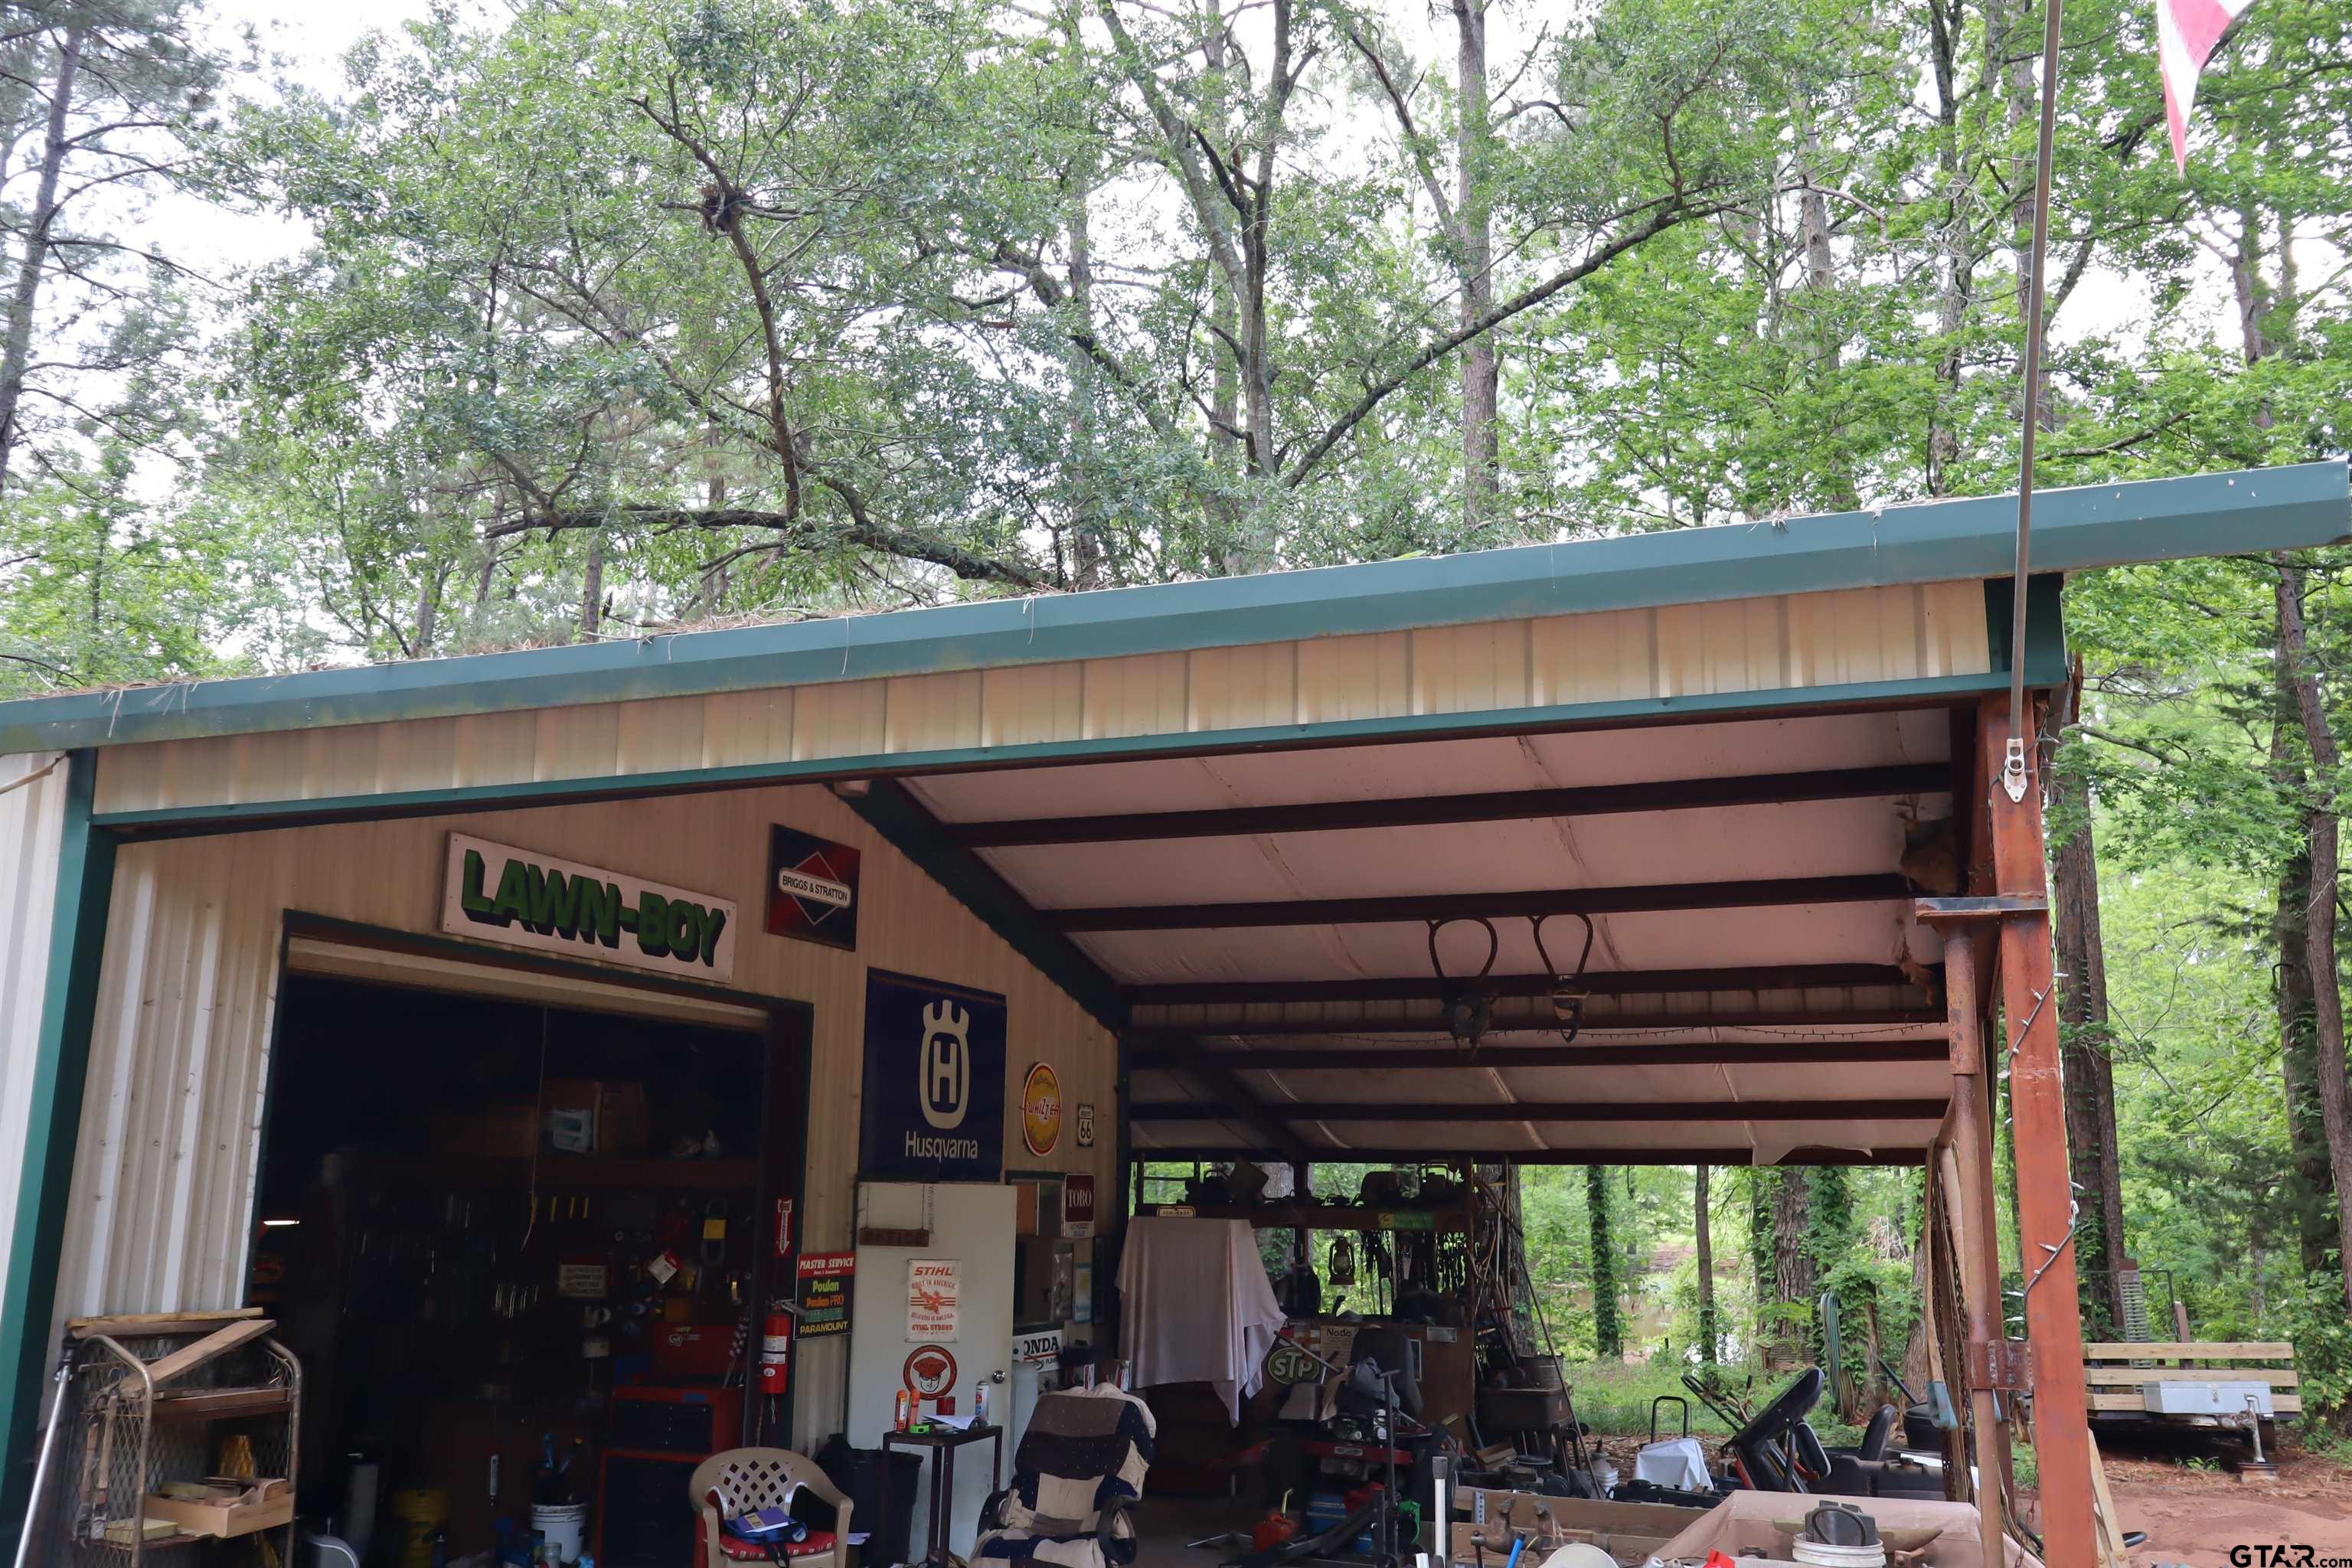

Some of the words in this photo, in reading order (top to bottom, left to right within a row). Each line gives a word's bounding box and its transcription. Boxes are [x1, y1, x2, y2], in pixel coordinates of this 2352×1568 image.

[782, 875, 808, 891] BRIGGS
[809, 883, 815, 893] &
[815, 884, 848, 902] STRATTON
[462, 849, 727, 967] LAWN-BOY
[1027, 1099, 1060, 1120] WHIZZER
[1080, 1120, 1092, 1140] 66
[905, 1130, 978, 1163] Husqvarna
[1067, 1188, 1092, 1207] TORO
[799, 1259, 826, 1270] MASTER
[828, 1257, 854, 1269] SERVICE
[913, 1266, 952, 1276] STIHL
[812, 1279, 840, 1293] Poulan
[830, 1293, 845, 1306] PRO
[799, 1321, 849, 1334] PARAMOUNT
[1024, 1336, 1060, 1356] ONDA
[1274, 1351, 1313, 1379] STP
